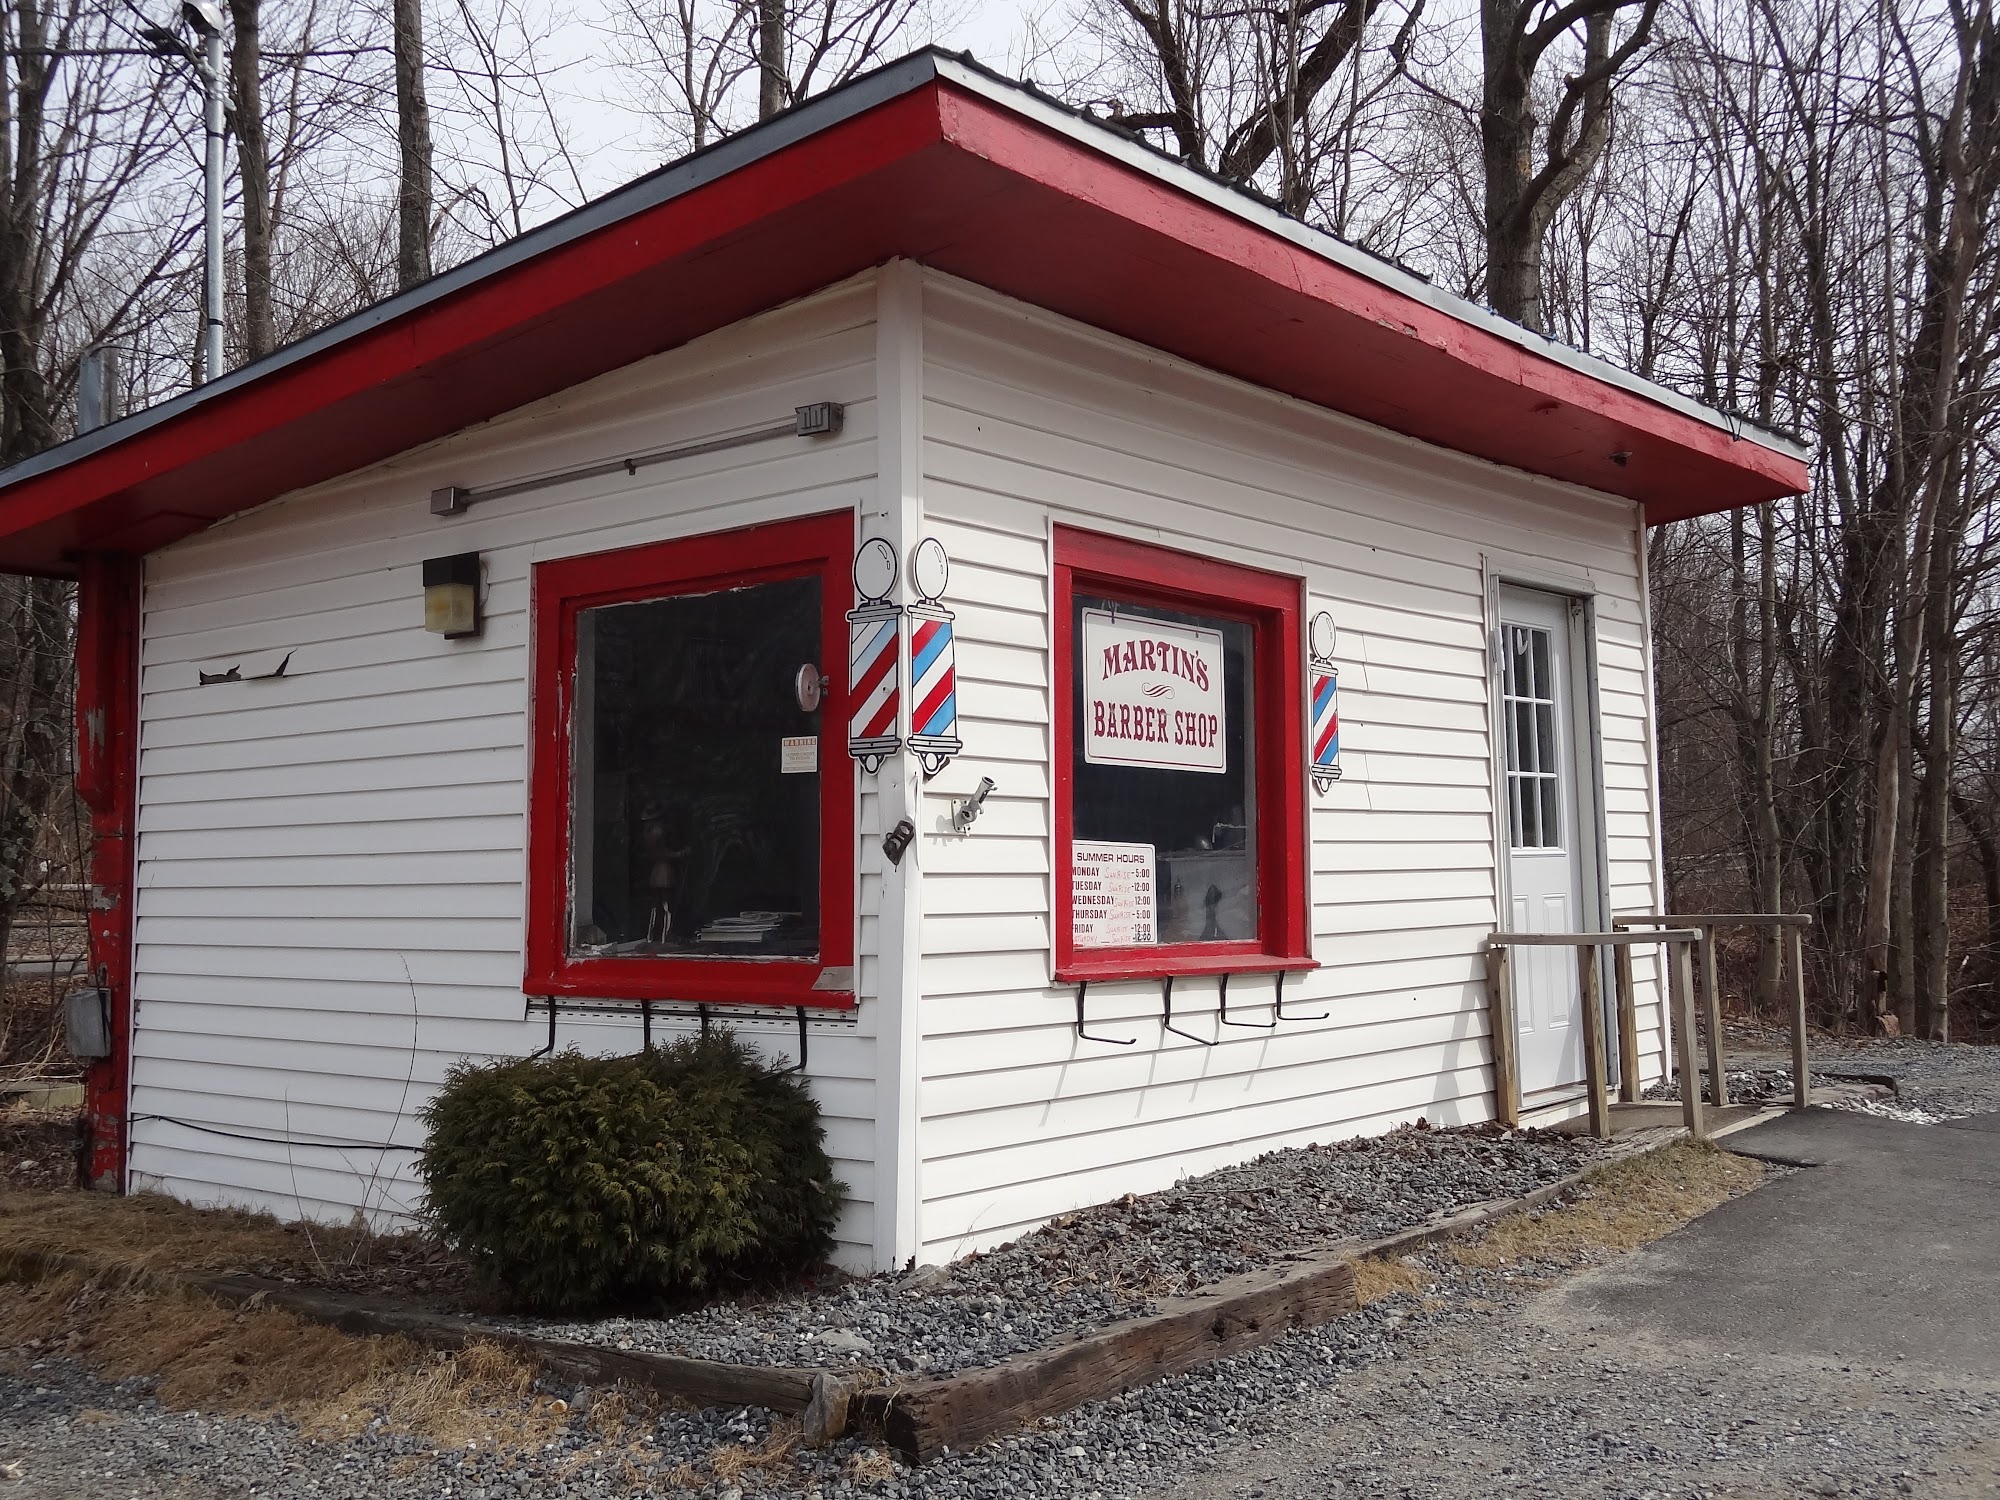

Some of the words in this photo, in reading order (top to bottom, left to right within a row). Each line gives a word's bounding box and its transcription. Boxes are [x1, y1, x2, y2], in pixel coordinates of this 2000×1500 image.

[1102, 639, 1209, 692] MARTIN'S
[1093, 700, 1169, 743] BARBER
[1174, 709, 1218, 748] SHOP
[1076, 852, 1114, 862] SUMMER
[1116, 854, 1145, 863] HOURS
[1073, 923, 1094, 933] RIDAY
